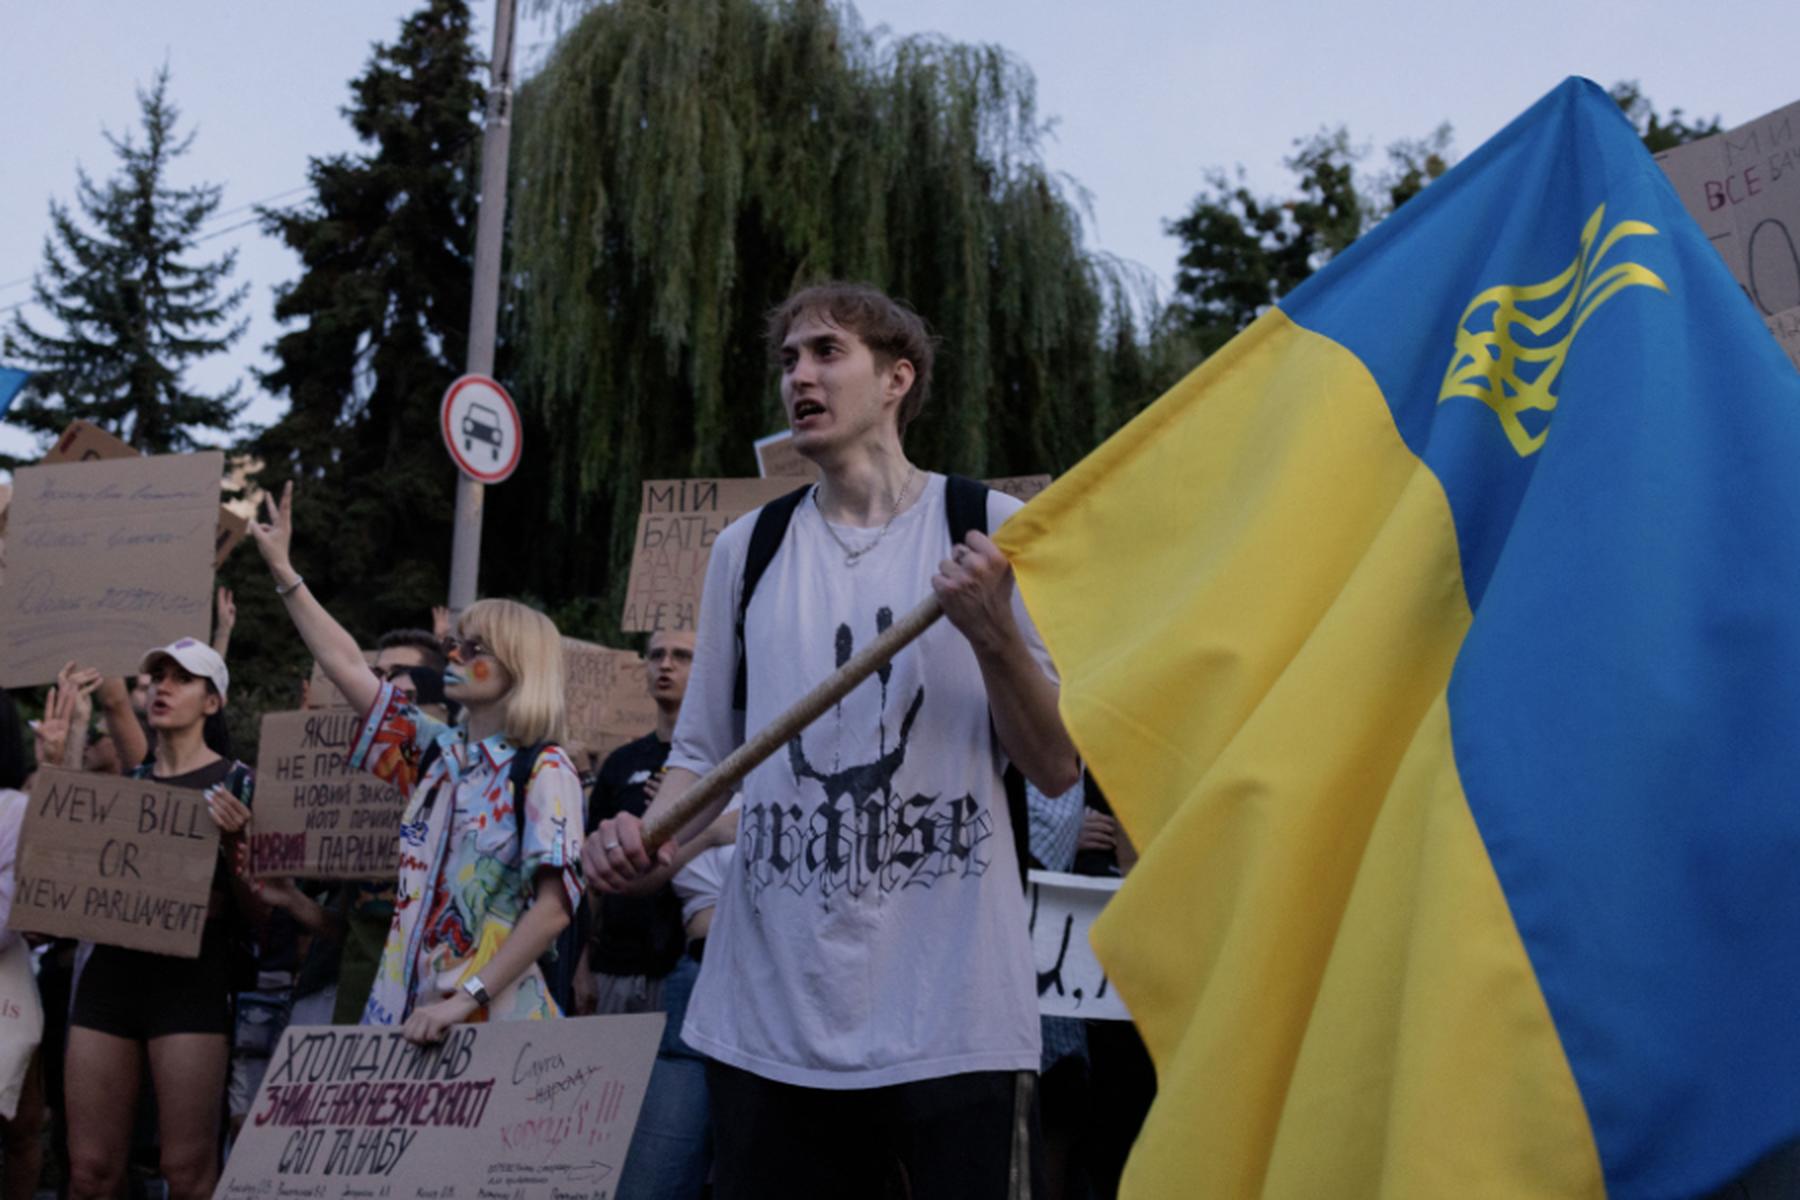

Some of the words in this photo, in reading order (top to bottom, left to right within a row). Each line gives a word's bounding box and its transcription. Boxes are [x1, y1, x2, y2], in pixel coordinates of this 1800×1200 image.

[1704, 167, 1762, 212] ВСЕ
[649, 480, 718, 513] МІЙ
[276, 754, 305, 780] НЕ
[40, 783, 119, 825] NEW
[97, 838, 141, 880] OR
[15, 877, 77, 911] NEW
